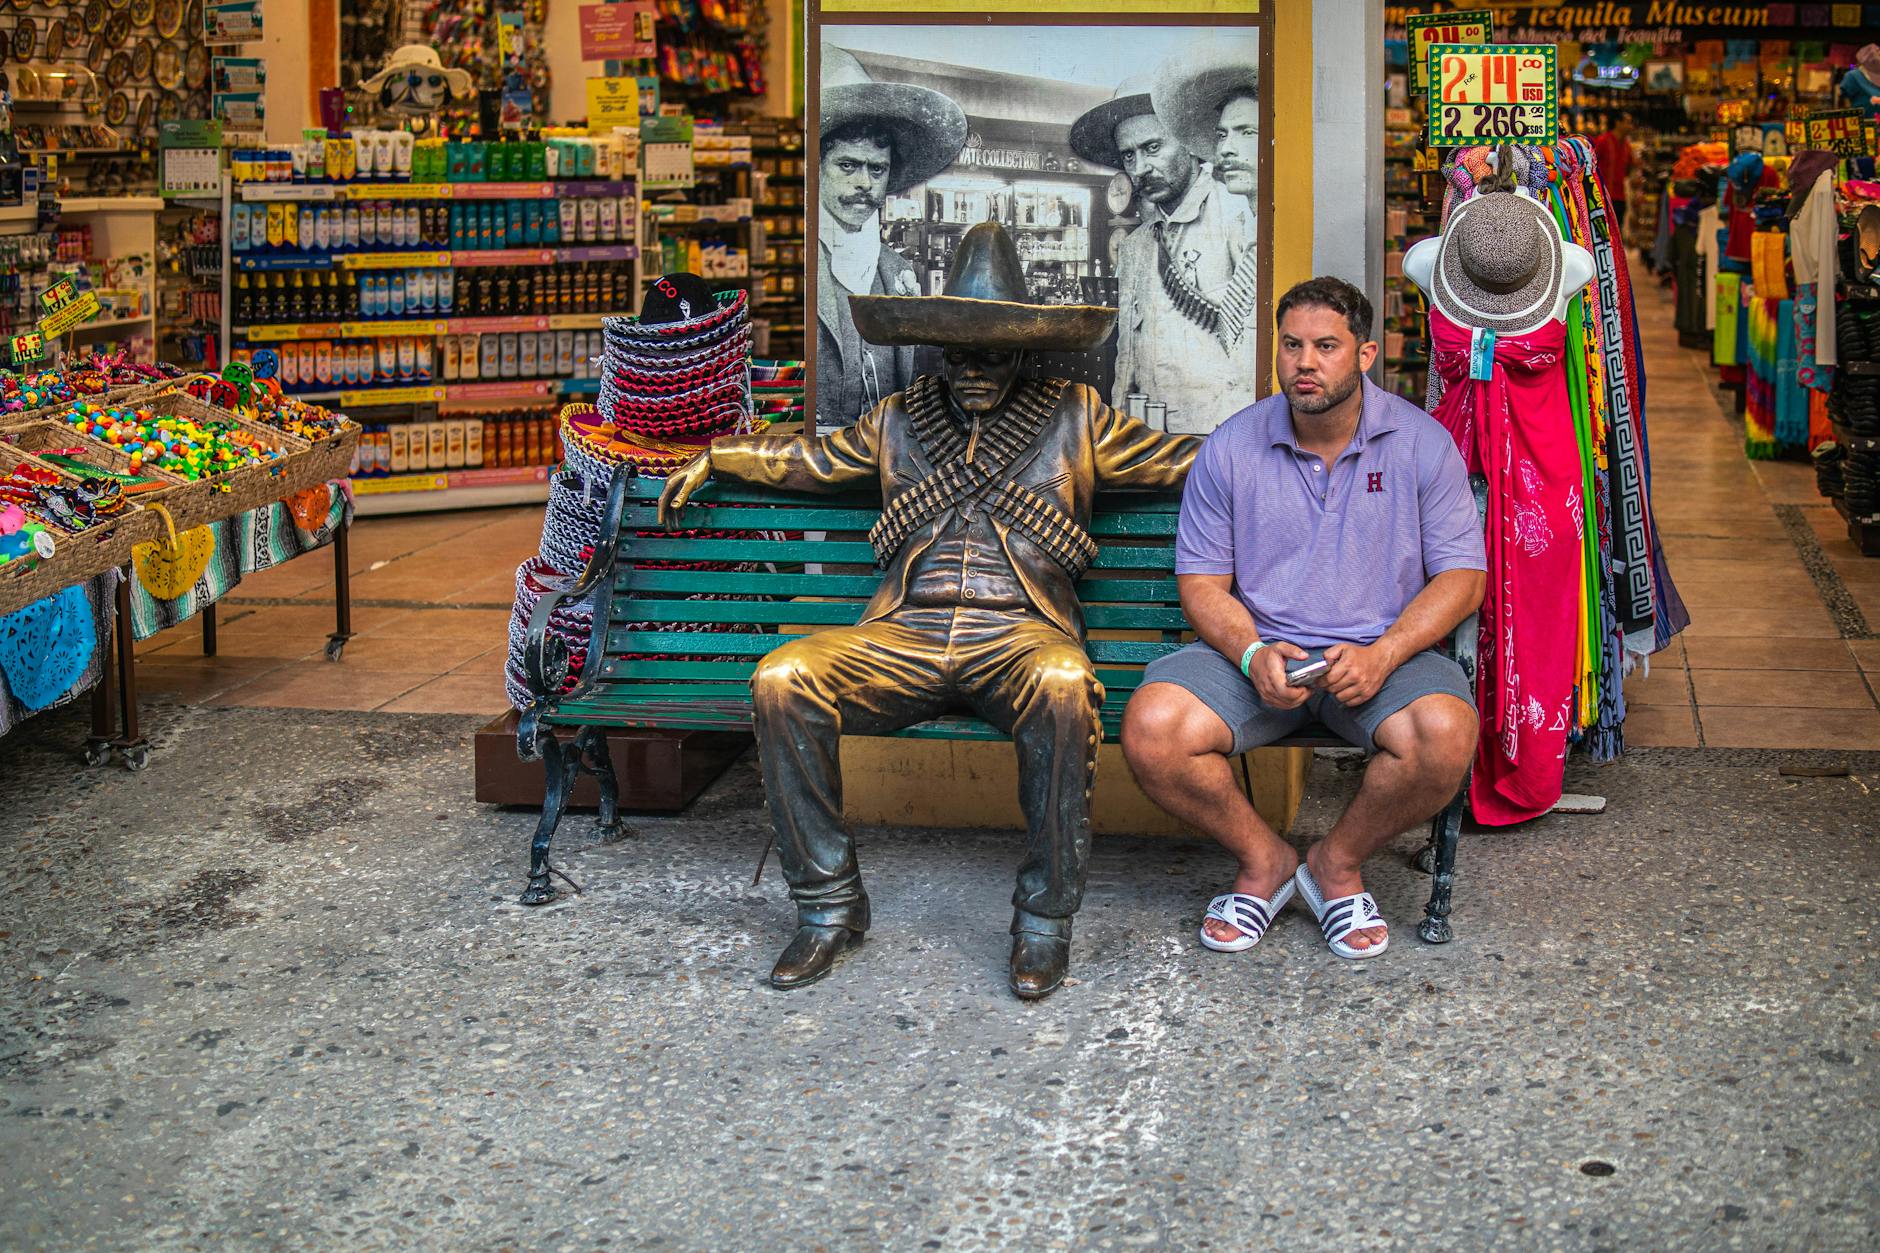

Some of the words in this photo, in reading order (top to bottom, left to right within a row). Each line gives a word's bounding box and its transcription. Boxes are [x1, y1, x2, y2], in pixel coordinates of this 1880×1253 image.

[1646, 0, 1769, 26] Museum
[1442, 56, 1467, 103] 2
[1522, 88, 1543, 101] USD
[1444, 107, 1463, 138] 2
[1525, 125, 1543, 135] ESOS
[982, 149, 1041, 169] COLLECTION
[1367, 471, 1384, 493] H
